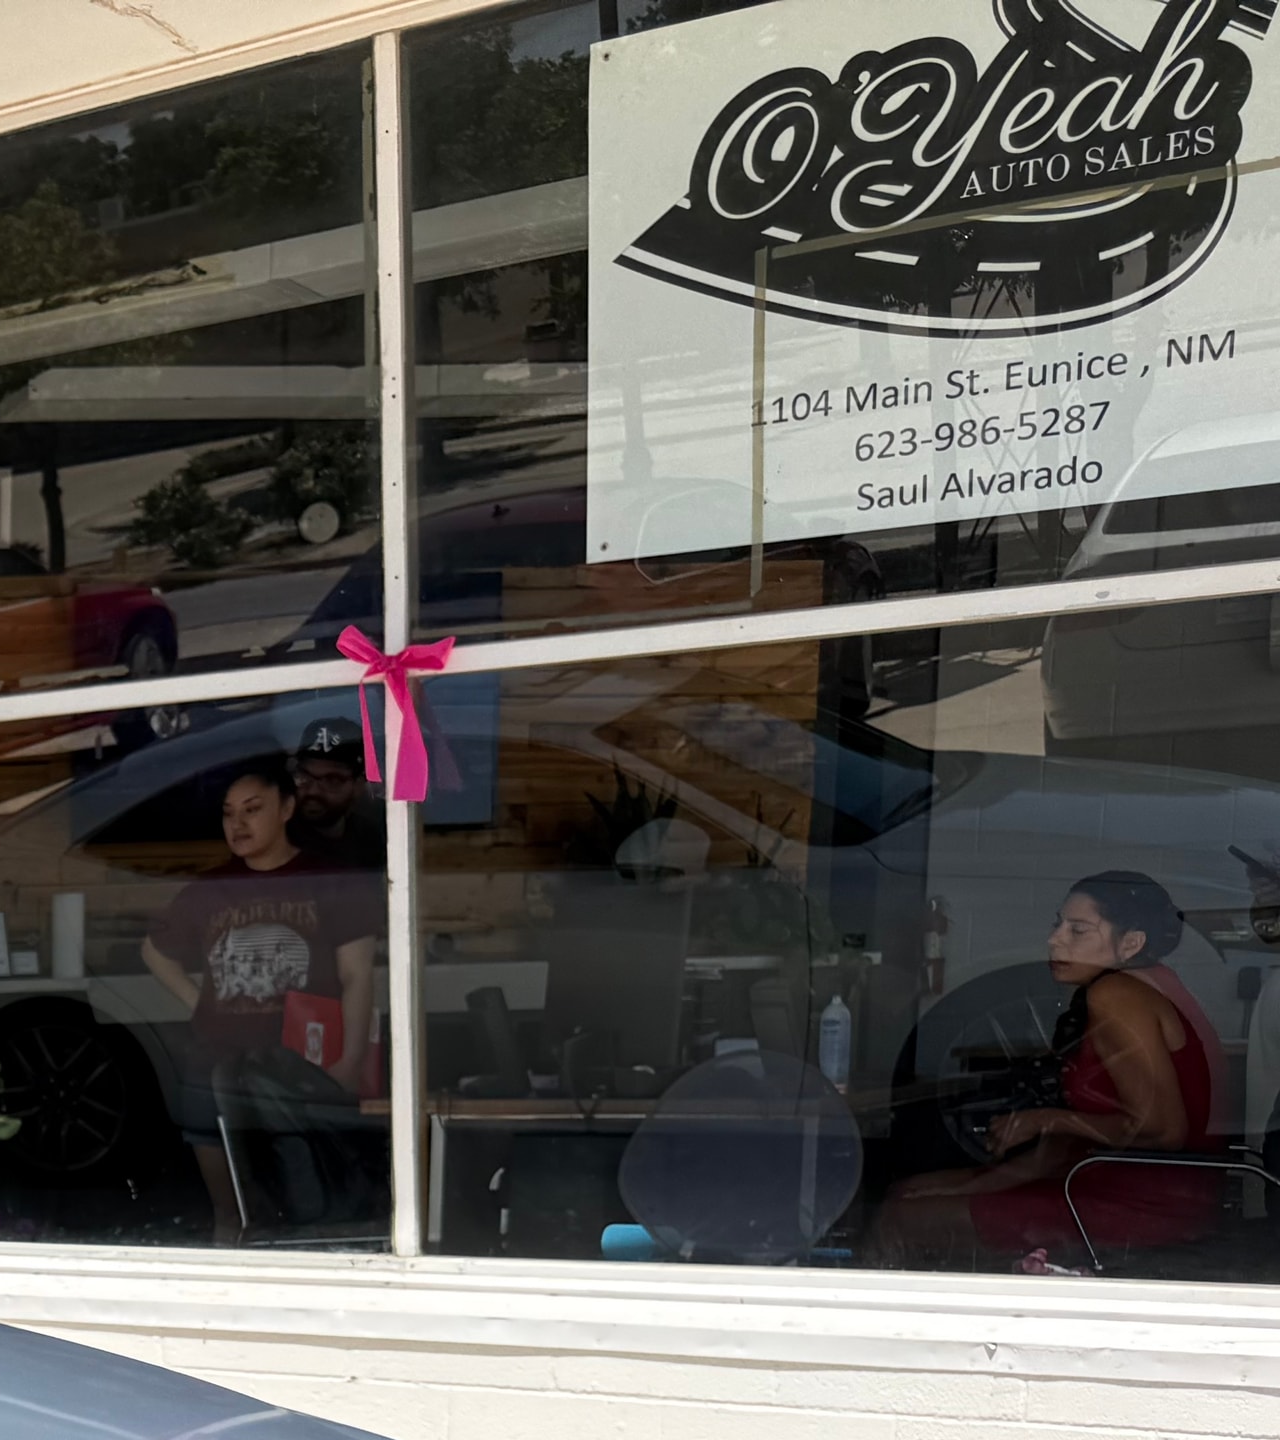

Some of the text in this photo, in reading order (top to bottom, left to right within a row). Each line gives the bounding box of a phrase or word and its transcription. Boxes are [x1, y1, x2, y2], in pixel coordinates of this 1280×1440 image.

[959, 125, 1216, 199] AUTO SALES
[750, 389, 833, 428] 1104
[845, 376, 933, 414] Main
[945, 369, 991, 400] St.
[1005, 350, 1129, 391] Eunice
[1165, 329, 1237, 368] NM
[854, 400, 1111, 462] 623-986-5287
[856, 456, 1104, 511] Saul Alvarado
